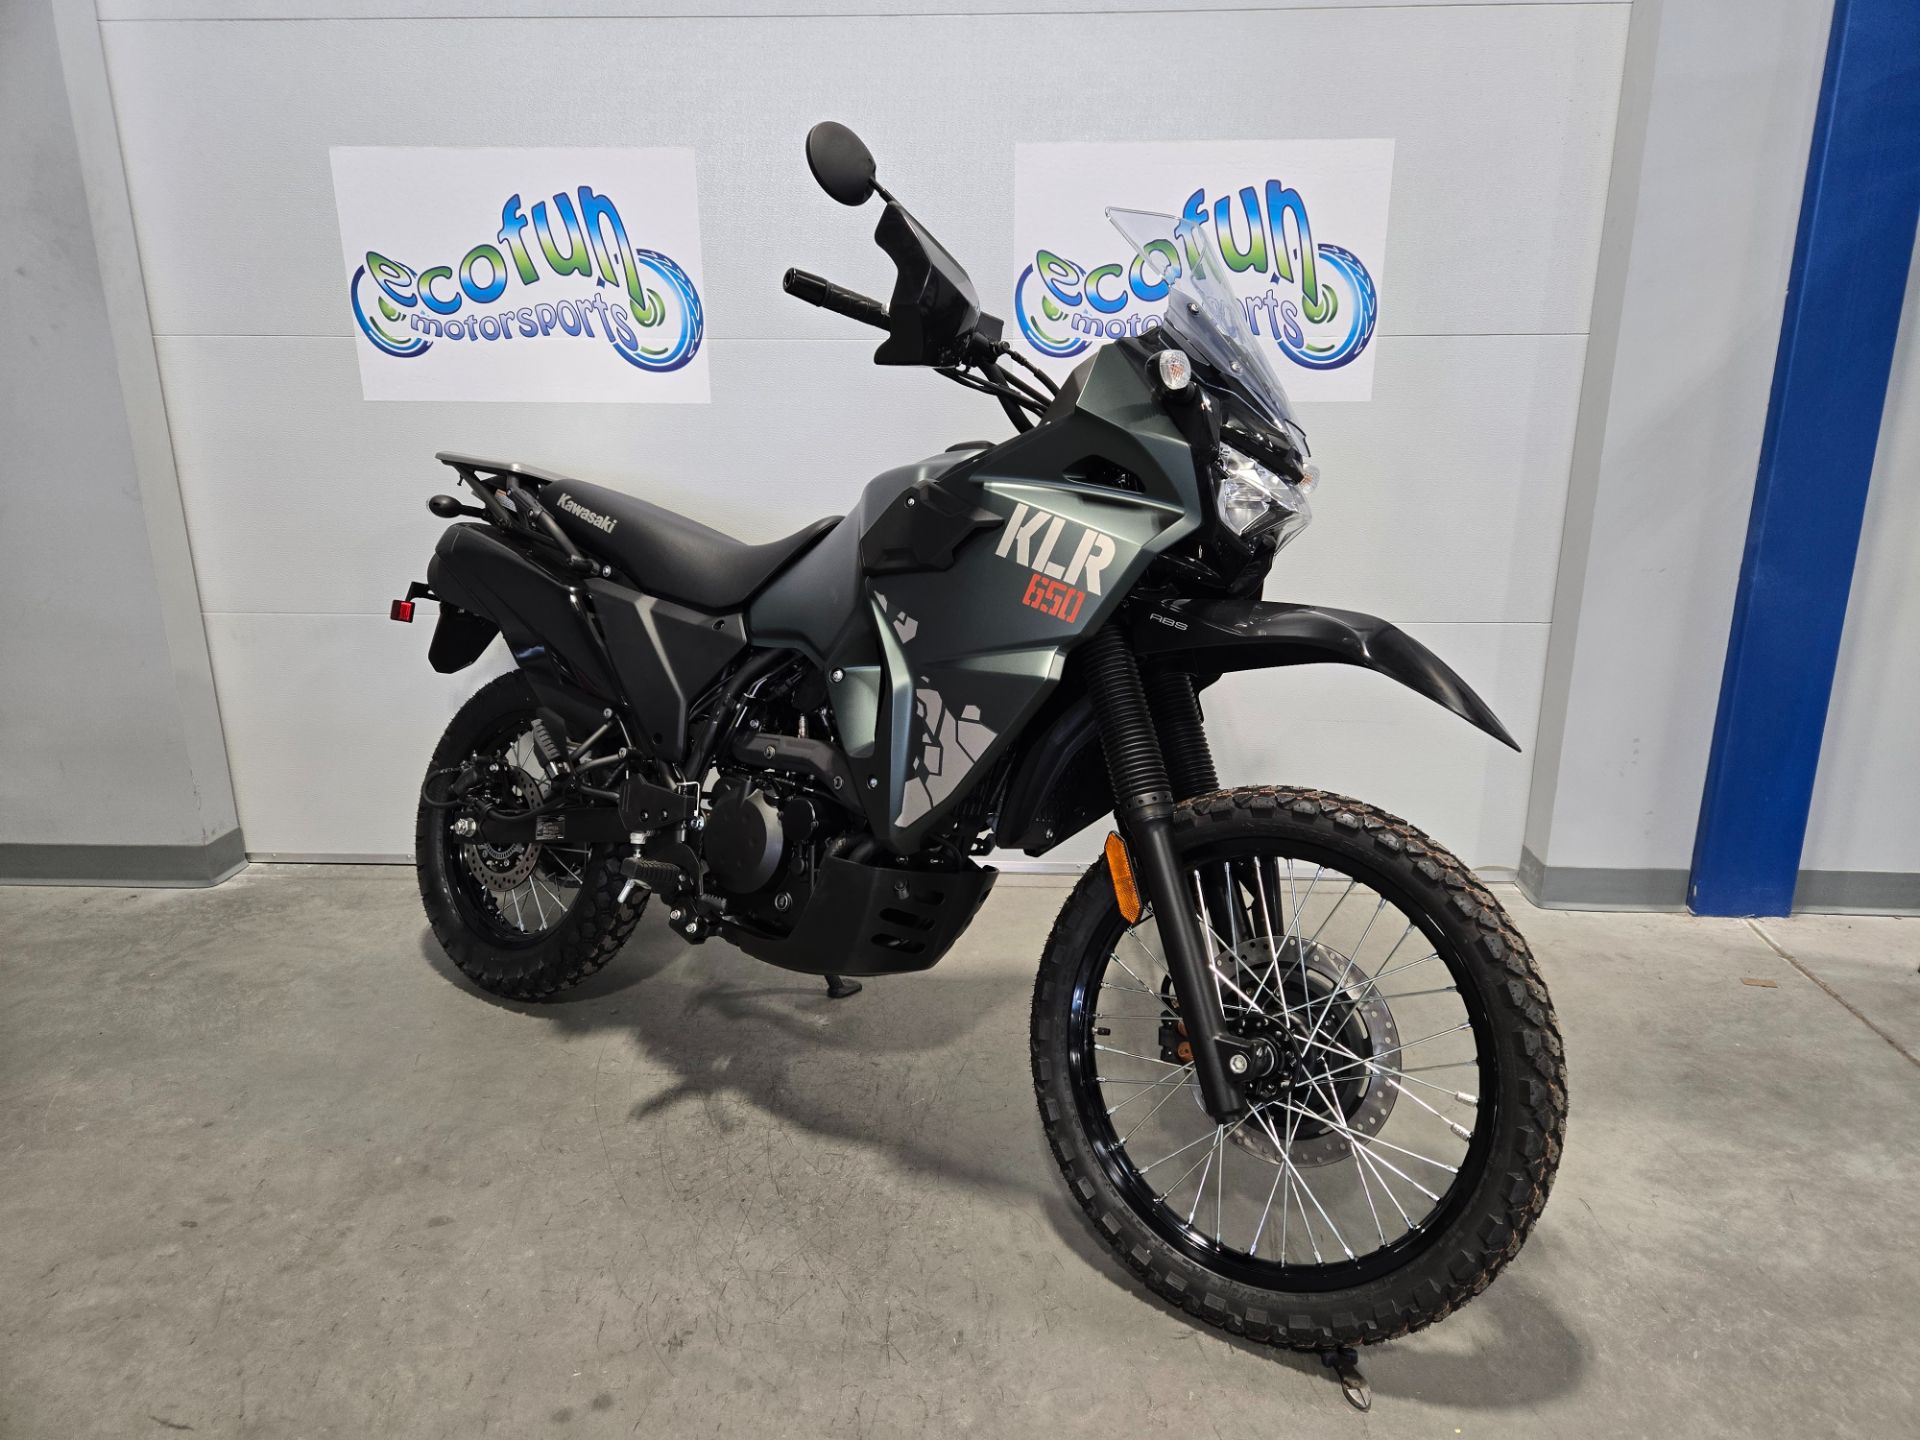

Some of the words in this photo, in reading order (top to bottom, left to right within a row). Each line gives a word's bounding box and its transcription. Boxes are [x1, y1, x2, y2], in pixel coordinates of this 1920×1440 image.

[411, 293, 638, 350] motorsports
[557, 493, 618, 534] Kawasaki
[995, 503, 1116, 596] KLR
[1022, 573, 1085, 624] 650
[1149, 612, 1188, 631] ABS
